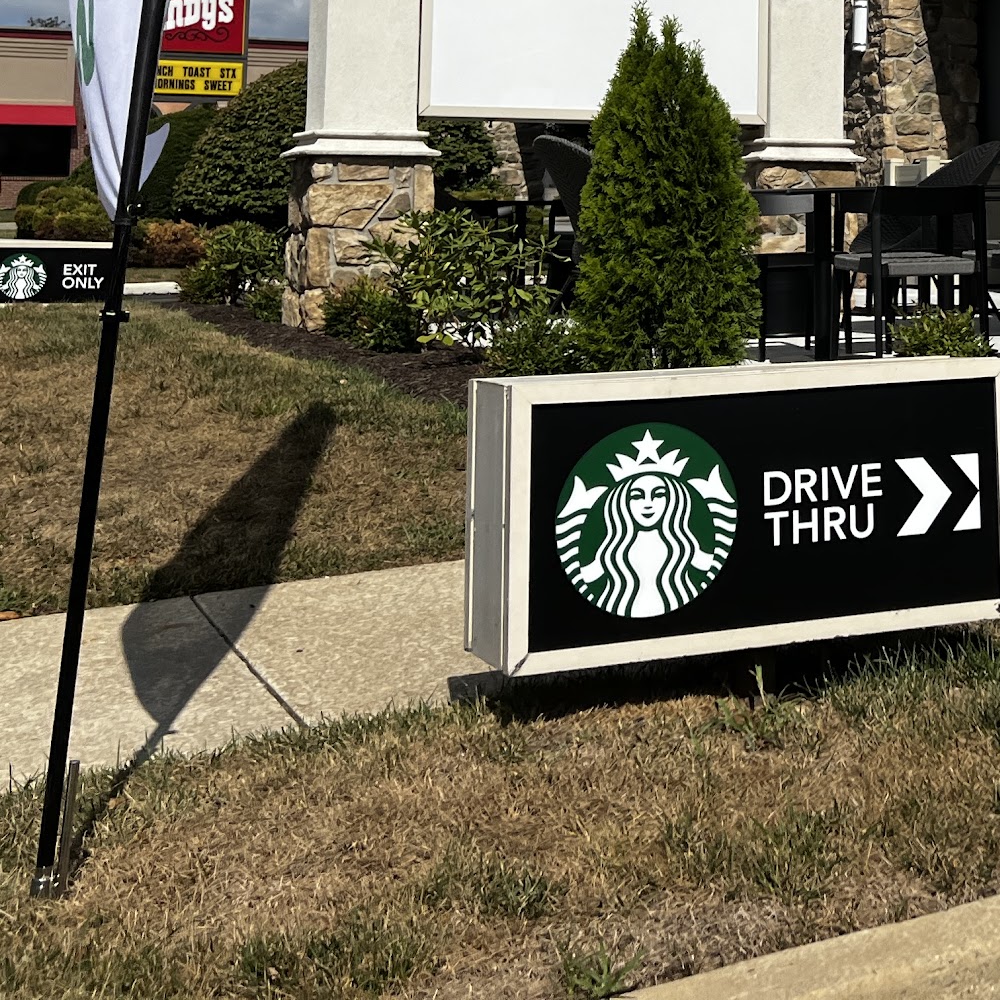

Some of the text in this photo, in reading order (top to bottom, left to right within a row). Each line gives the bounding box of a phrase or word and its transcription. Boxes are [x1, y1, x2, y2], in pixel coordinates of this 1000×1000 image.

[156, 65, 237, 79] NCH TOAST STX
[155, 79, 232, 91] ORNINGS SWEET
[63, 263, 97, 275] EXIT
[62, 277, 104, 289] ONLY
[762, 462, 884, 508] DRIVE
[763, 503, 876, 547] THRU
